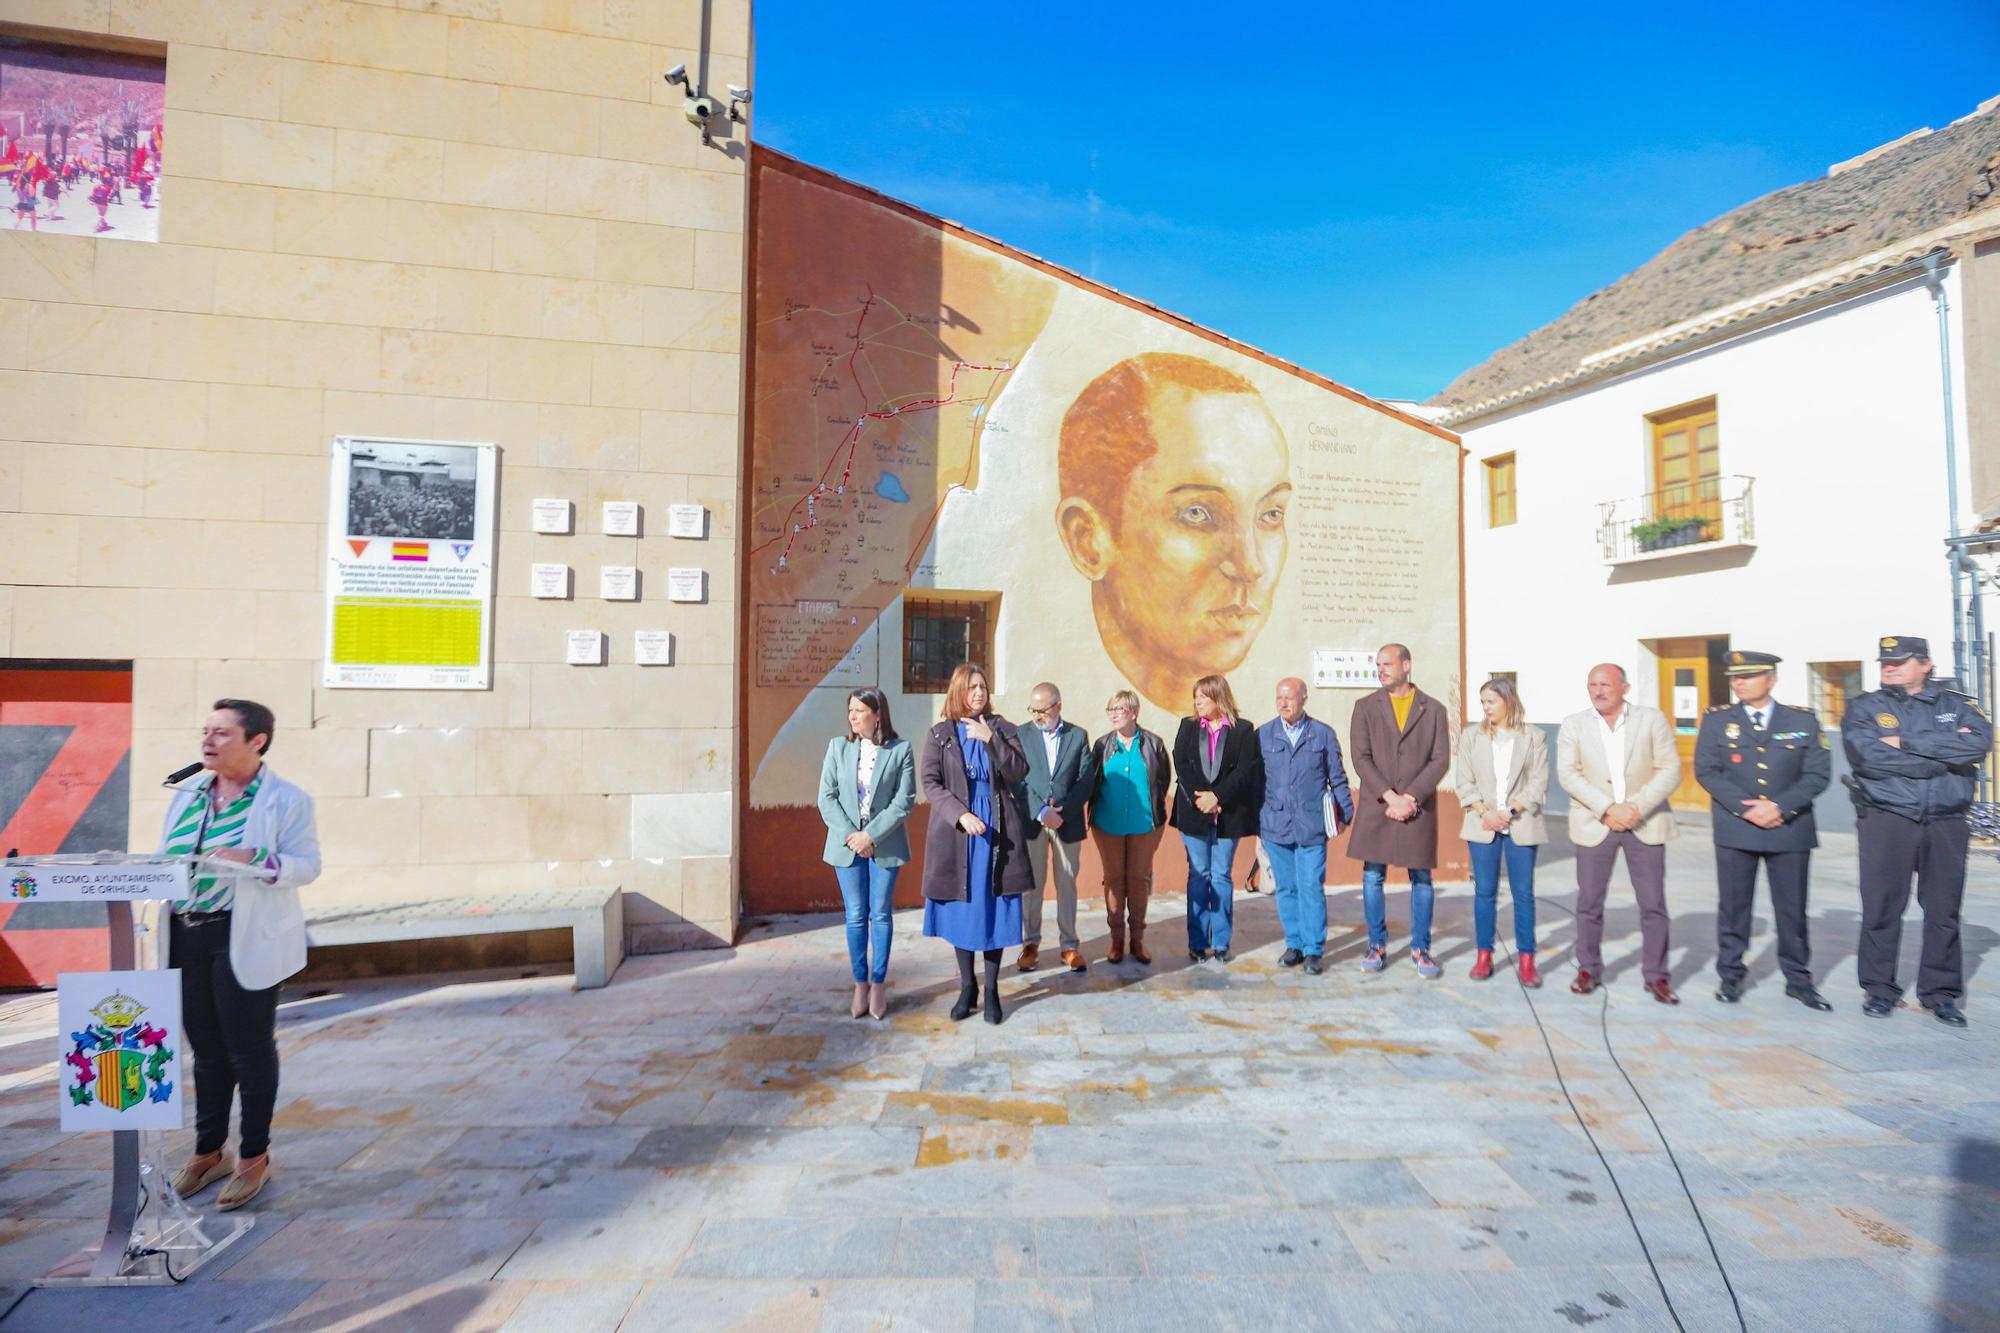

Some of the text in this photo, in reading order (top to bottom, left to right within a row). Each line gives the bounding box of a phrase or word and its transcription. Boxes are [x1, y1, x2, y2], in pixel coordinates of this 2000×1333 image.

[94, 873, 174, 884] AYUNTAMIENTO
[81, 884, 149, 894] DE ORIHUELA
